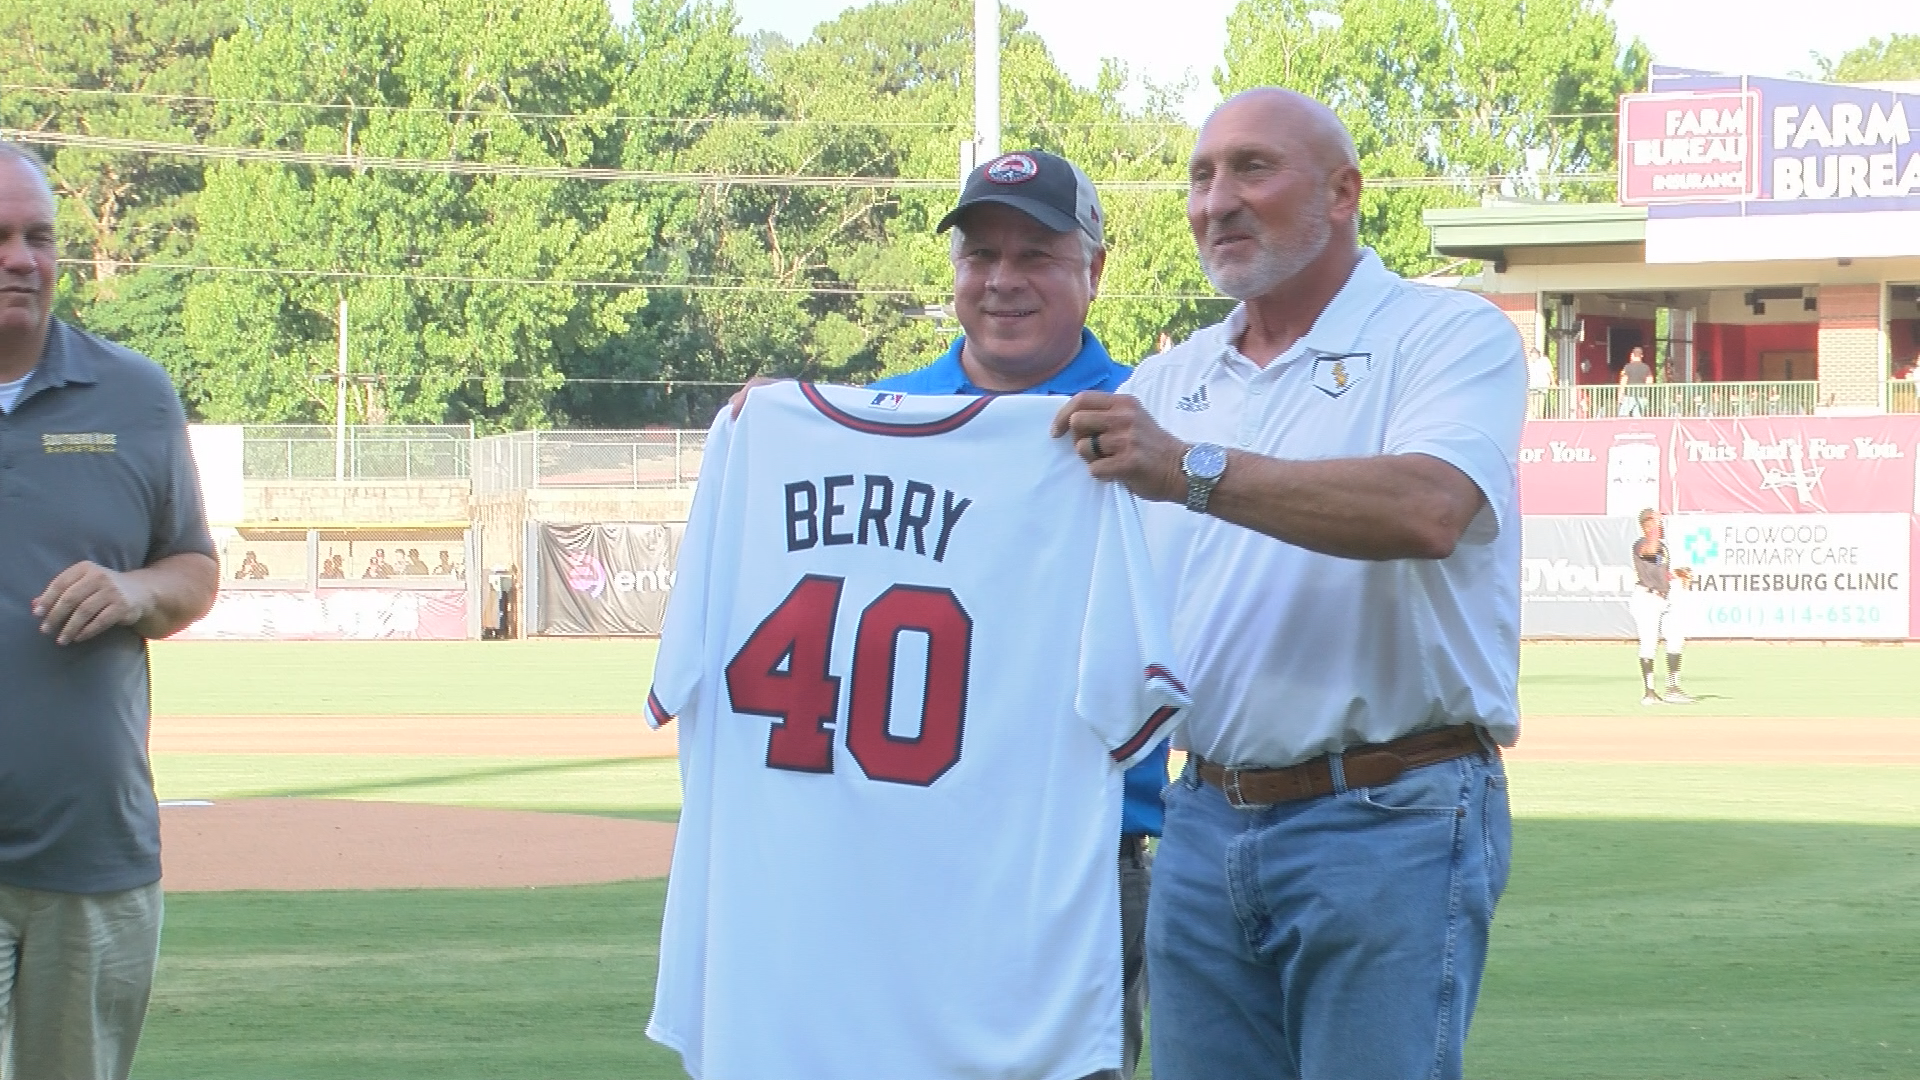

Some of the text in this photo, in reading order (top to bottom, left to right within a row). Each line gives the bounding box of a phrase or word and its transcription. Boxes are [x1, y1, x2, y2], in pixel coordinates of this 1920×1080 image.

[1665, 108, 1743, 137] FARM
[1772, 101, 1912, 151] FARM
[1634, 136, 1746, 166] BUREAU
[1652, 171, 1745, 192] INSURANC
[1549, 441, 1598, 463] You.
[1684, 440, 1737, 463] This
[1808, 438, 1850, 461] For
[1853, 437, 1904, 460] You.
[784, 474, 974, 563] BERRY
[1724, 526, 1828, 544] FLOWOOD
[1724, 546, 1859, 566] PRIMARY CARE
[1689, 572, 1899, 593] HATTIESBURG CLINIC
[1707, 604, 1881, 626] (601) 414-6520
[724, 572, 974, 788] 40
